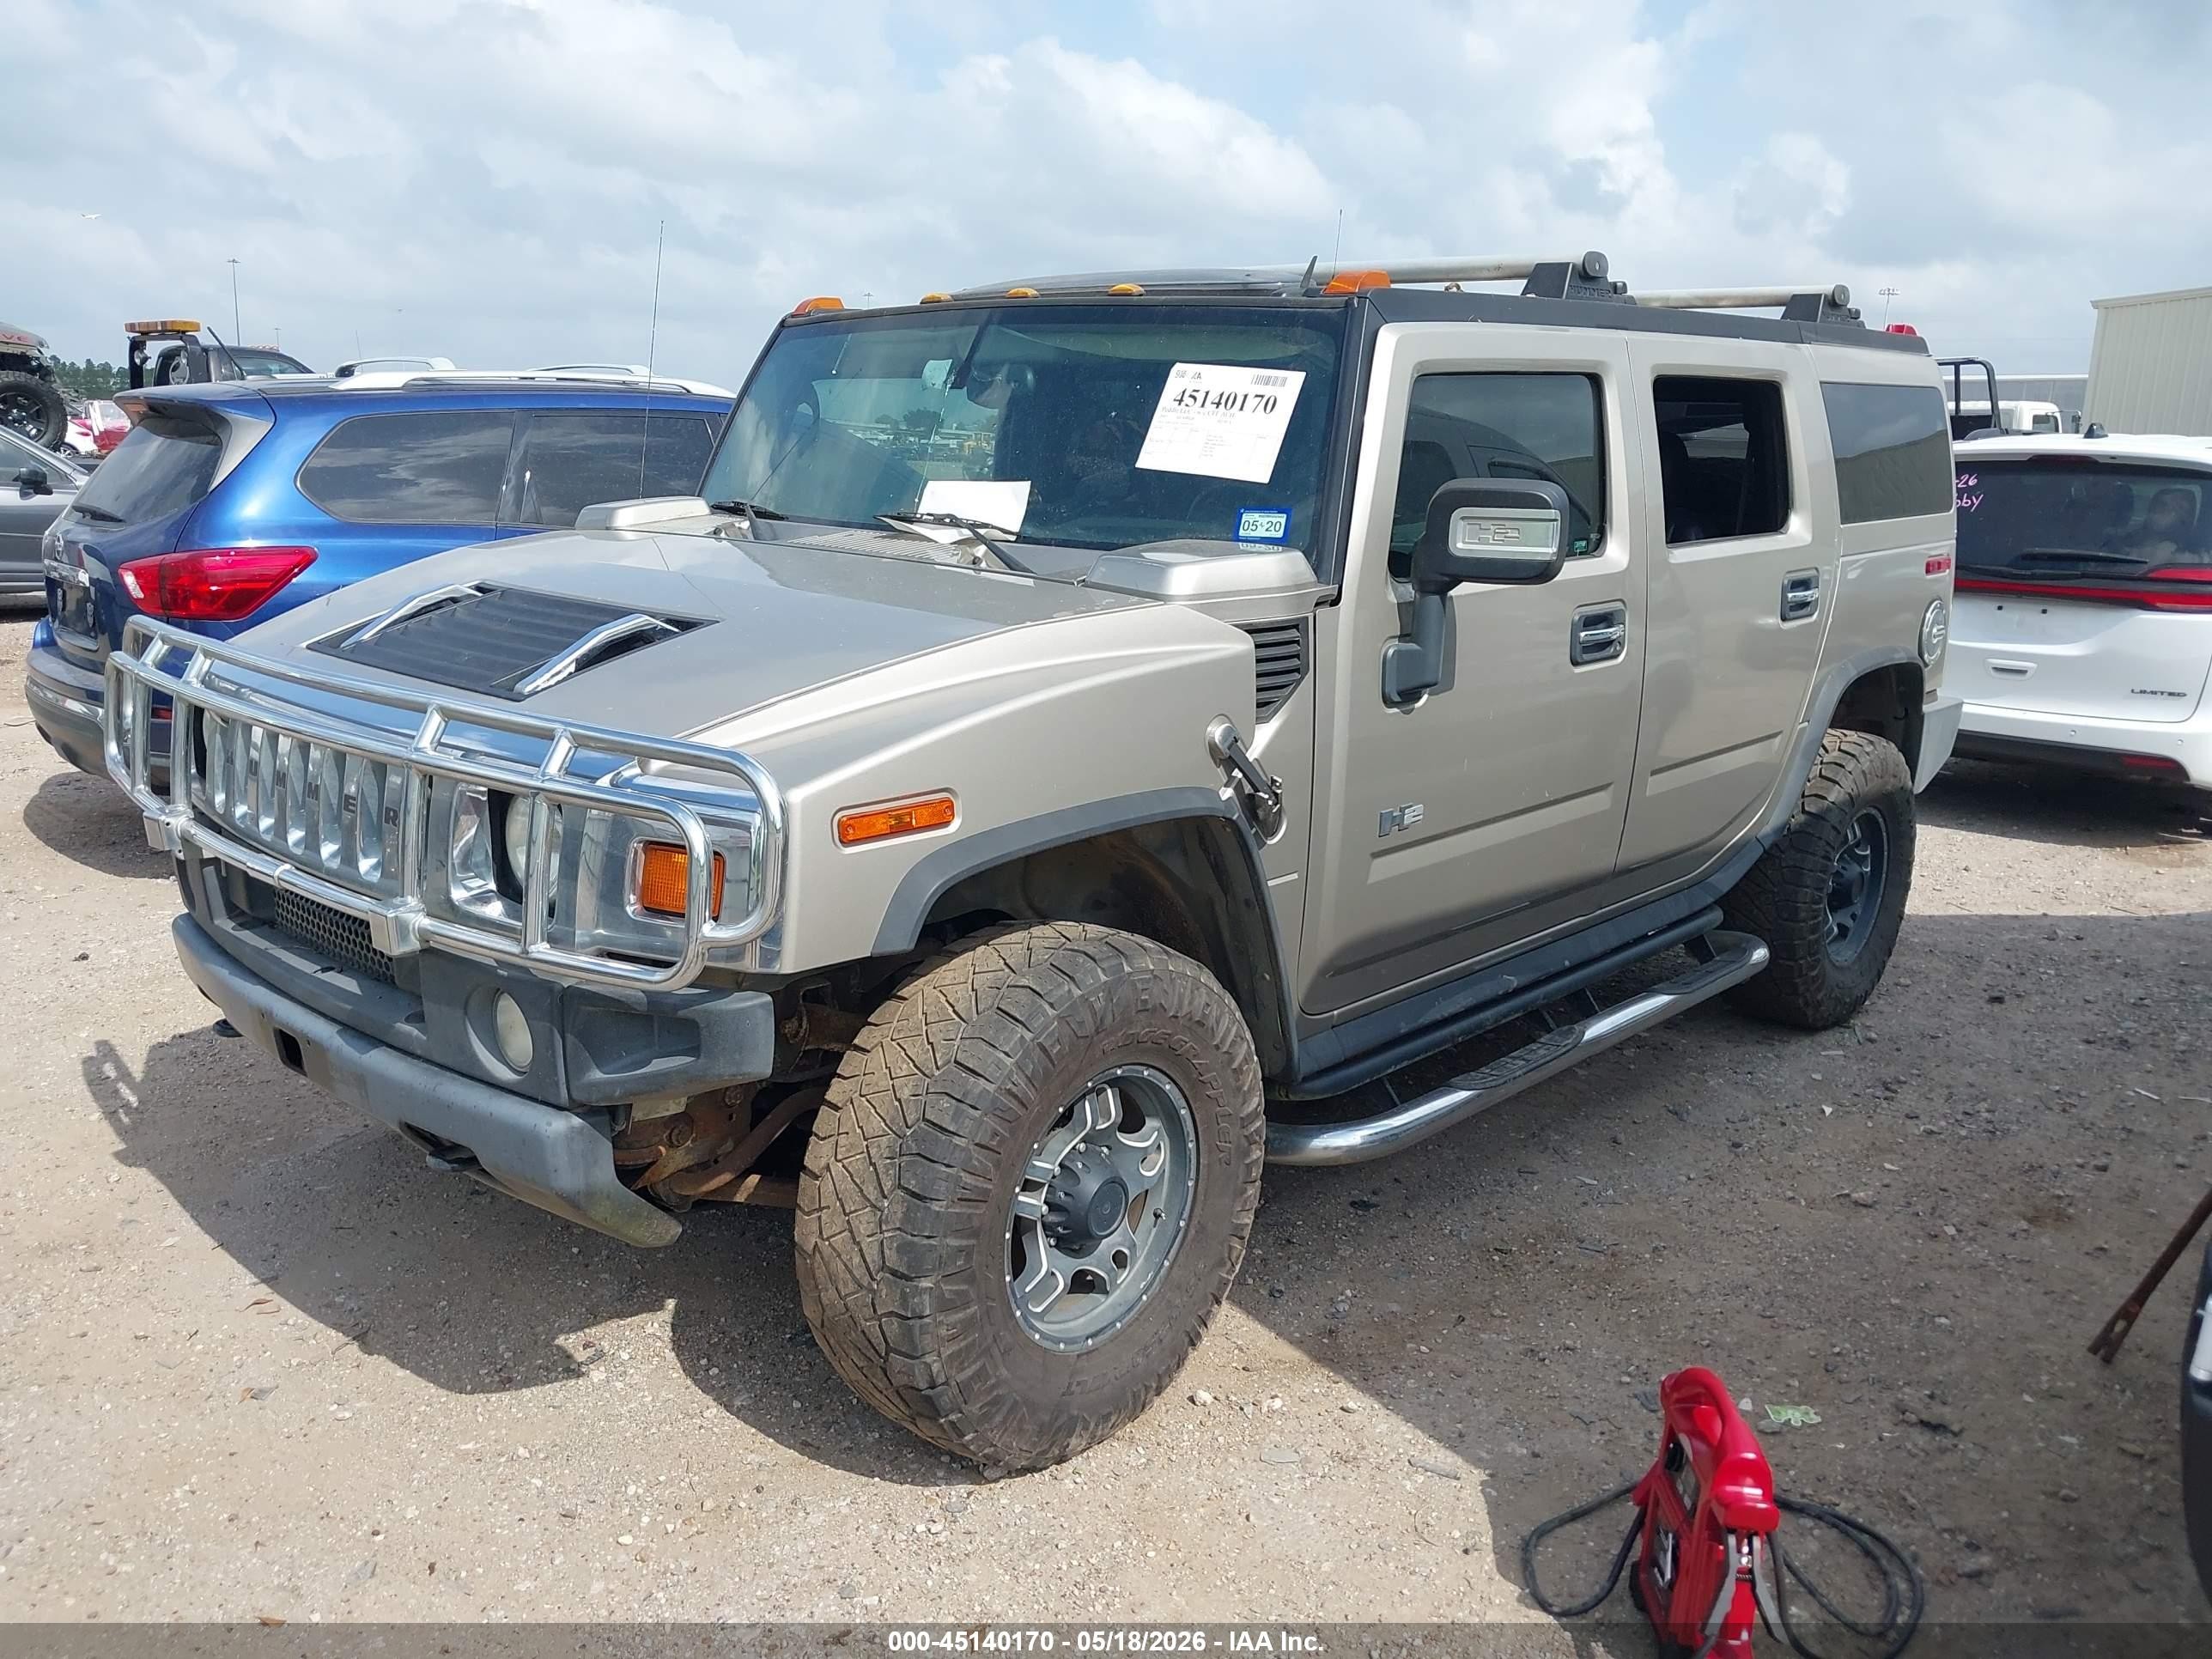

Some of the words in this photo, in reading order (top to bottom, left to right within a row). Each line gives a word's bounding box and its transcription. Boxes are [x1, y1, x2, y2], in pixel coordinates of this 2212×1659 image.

[1173, 387, 1278, 415] 45140170
[1242, 520, 1260, 532] 05
[1265, 520, 1282, 533] 20
[2130, 689, 2187, 697] LIMITED
[1377, 802, 1425, 838] H2
